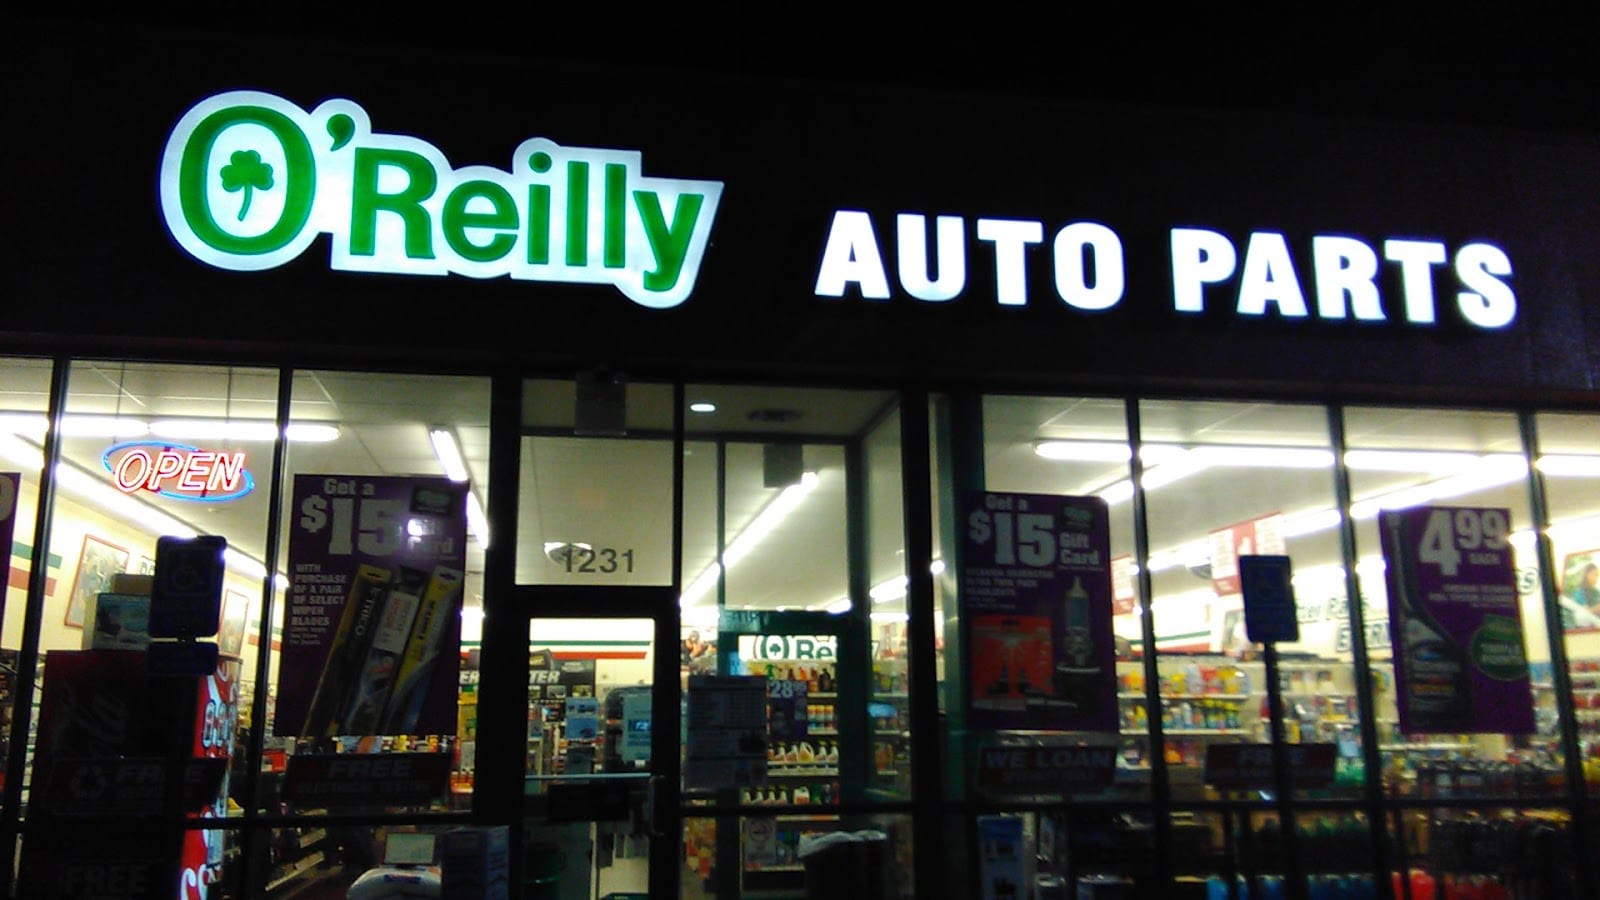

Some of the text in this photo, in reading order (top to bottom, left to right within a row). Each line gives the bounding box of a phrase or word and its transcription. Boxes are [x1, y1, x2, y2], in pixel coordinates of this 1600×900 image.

[814, 210, 1518, 328] AUTO PARTS
[112, 449, 246, 494] OPEN
[323, 478, 376, 496] Get a
[985, 494, 1013, 511] Get
[300, 494, 403, 557] $15
[407, 536, 455, 554] ard
[968, 509, 1056, 568] $15
[1058, 531, 1090, 549] Gift
[563, 549, 635, 575] 1231
[1059, 549, 1100, 565] Card
